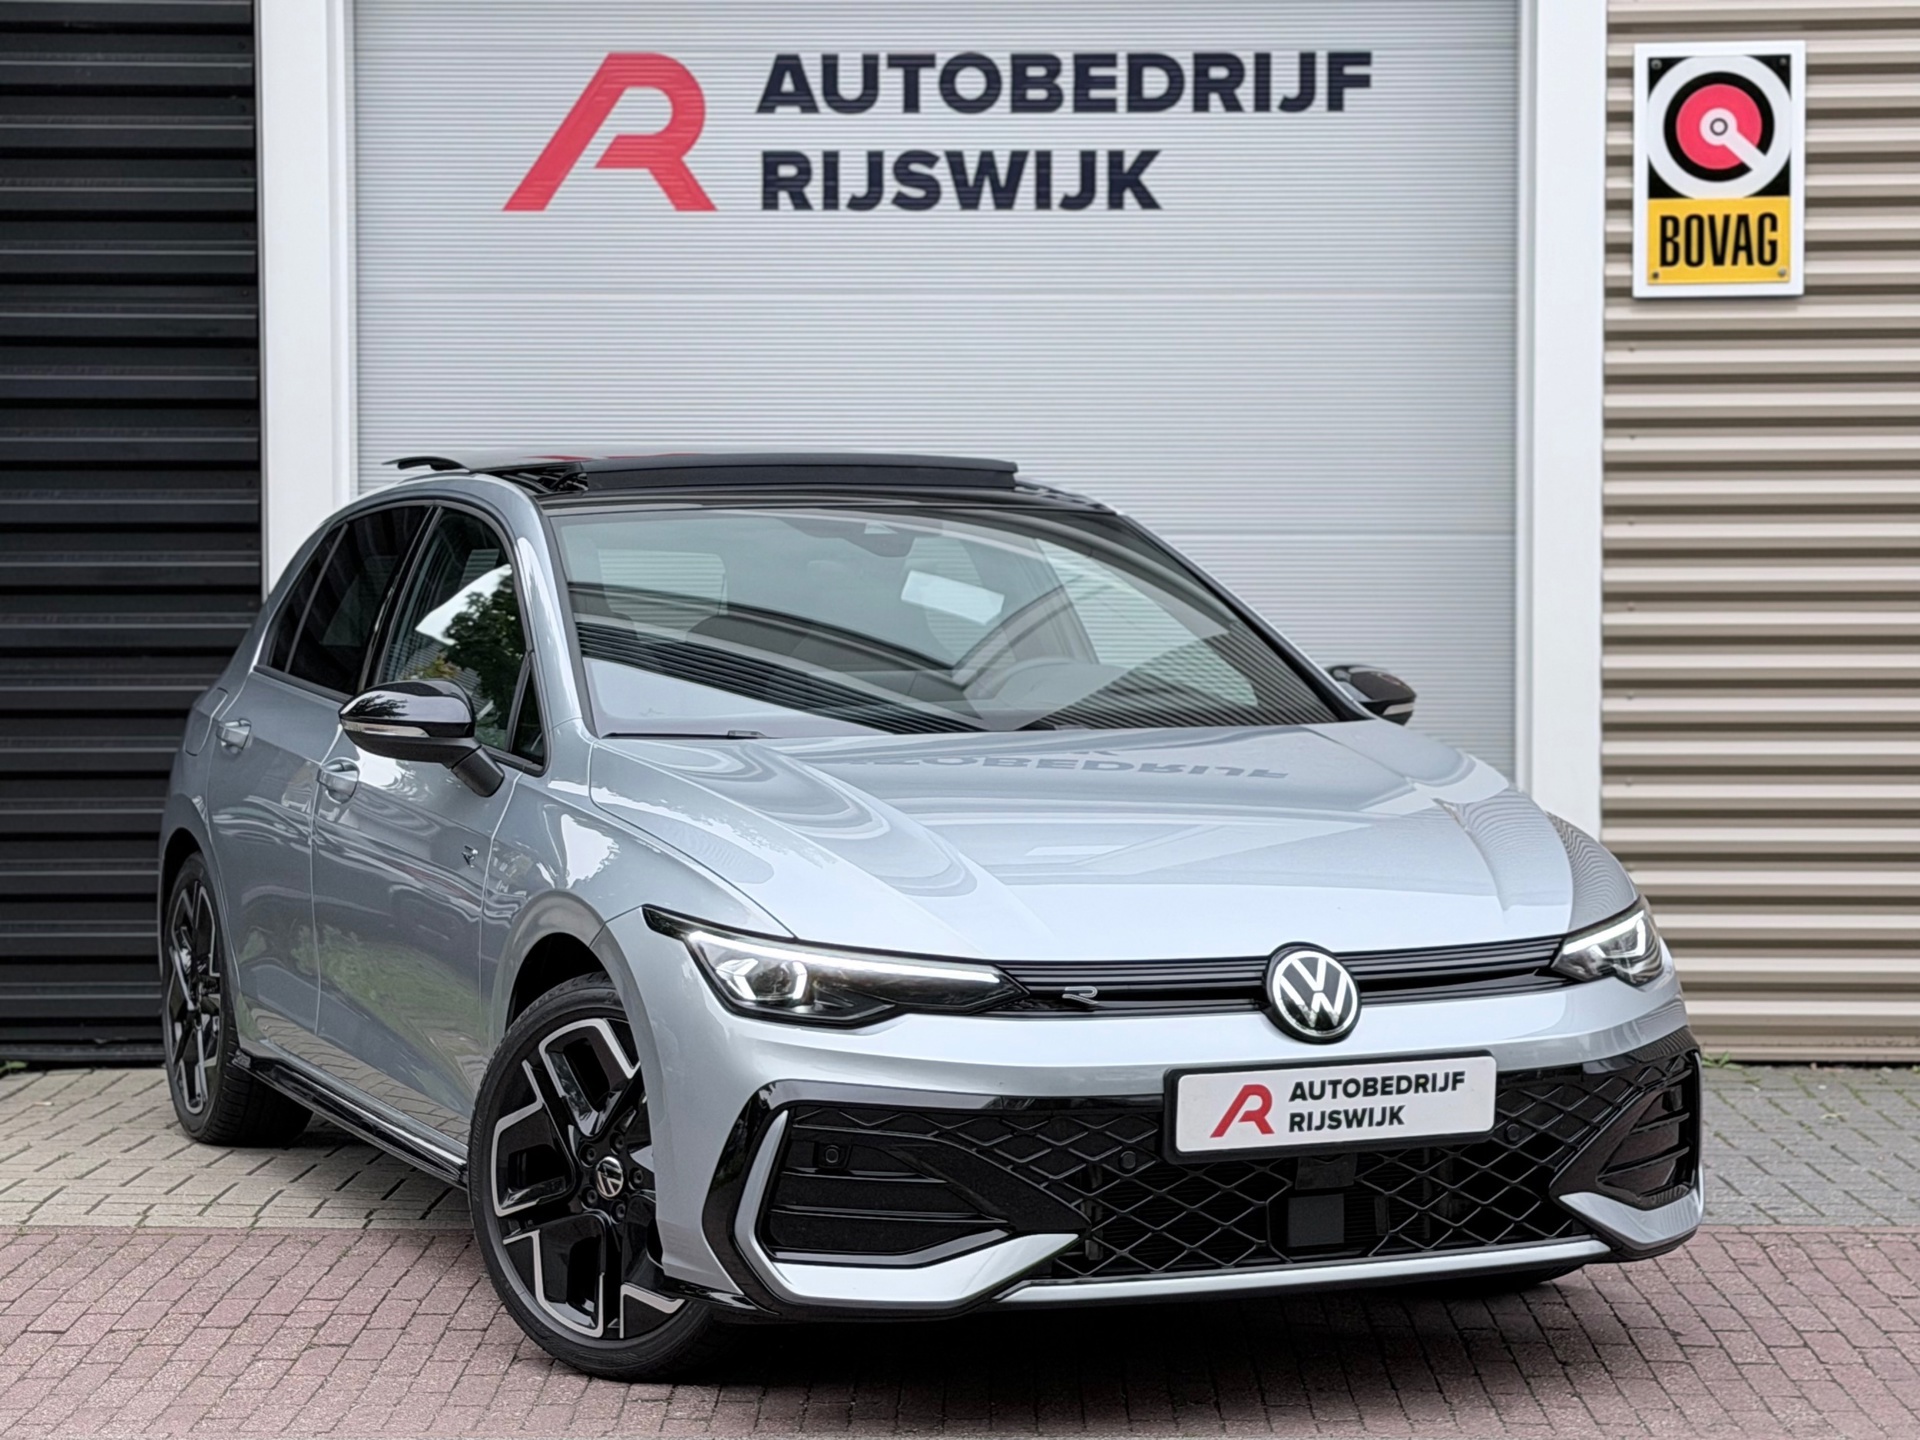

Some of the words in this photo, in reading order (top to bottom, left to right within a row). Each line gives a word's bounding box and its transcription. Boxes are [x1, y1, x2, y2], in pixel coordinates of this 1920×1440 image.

[757, 51, 1372, 114] AUTOBEDRIJF
[761, 149, 1161, 211] RIJSWIJK
[1659, 211, 1778, 268] BOVAG
[1288, 1071, 1466, 1102] AUTOBEDRIJF
[1288, 1105, 1406, 1133] RIJSWIJK
